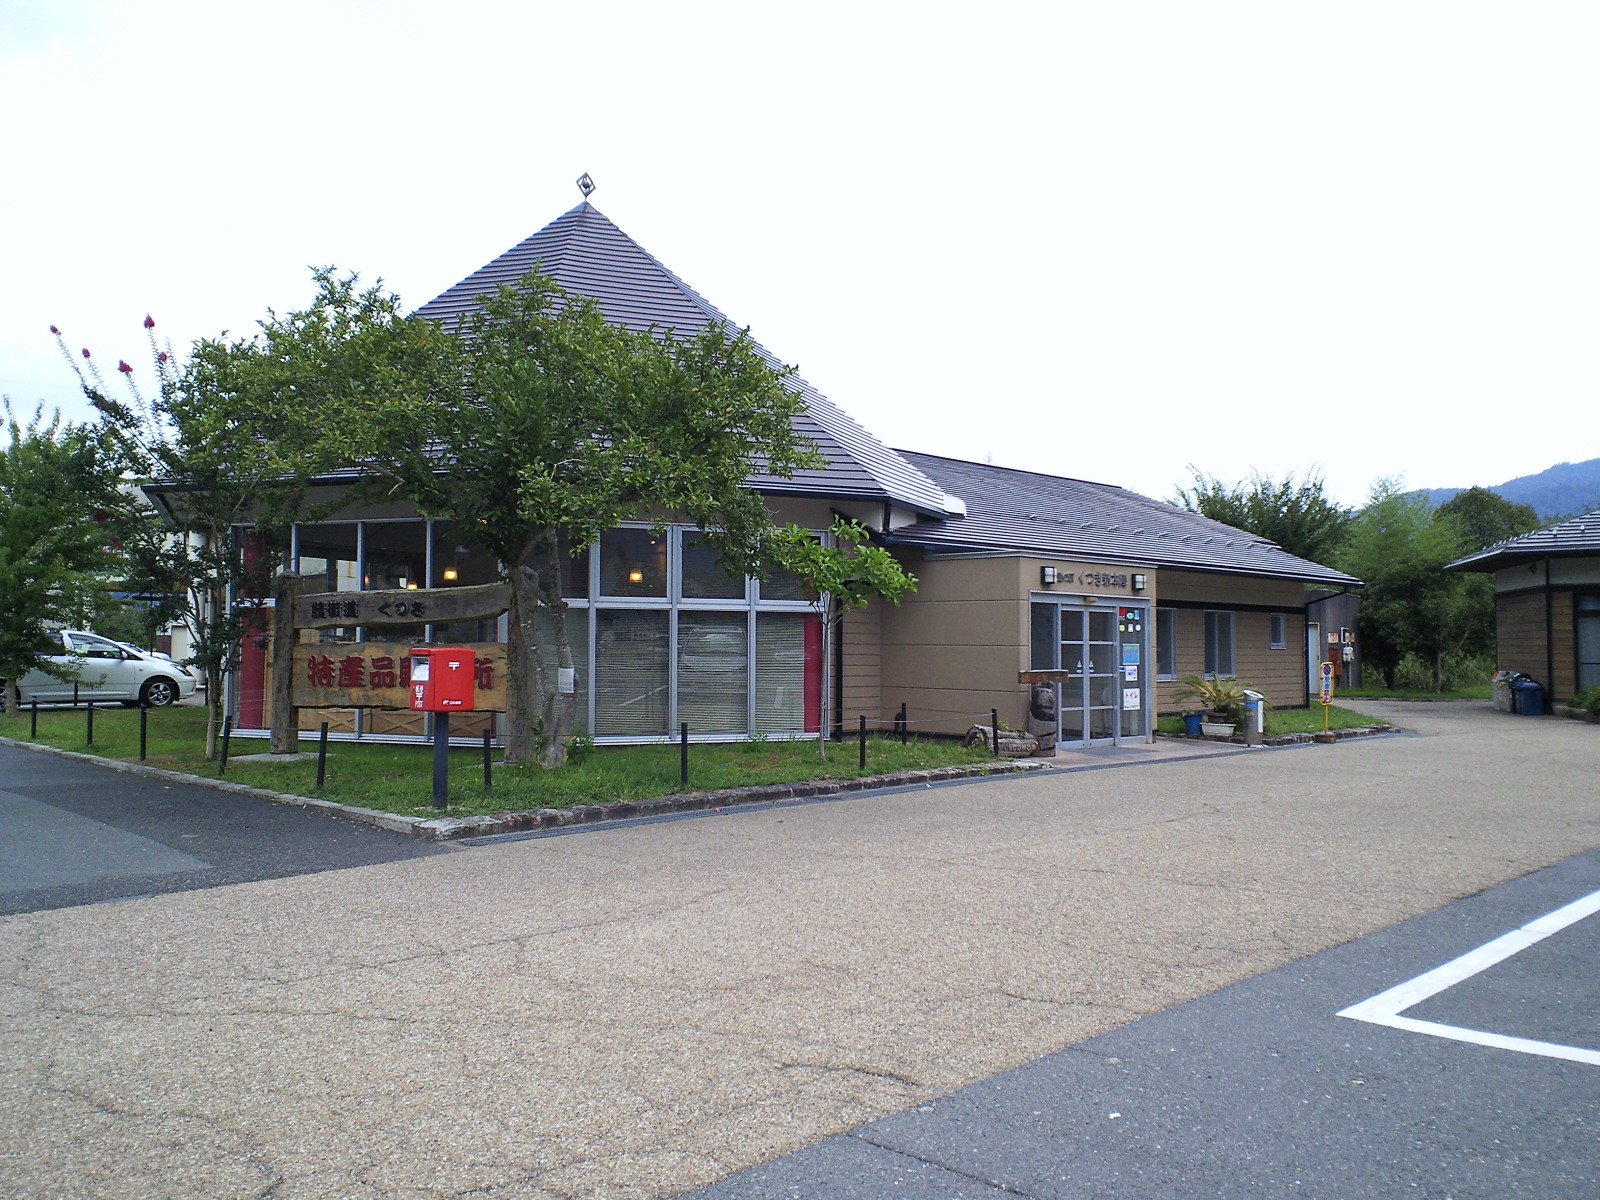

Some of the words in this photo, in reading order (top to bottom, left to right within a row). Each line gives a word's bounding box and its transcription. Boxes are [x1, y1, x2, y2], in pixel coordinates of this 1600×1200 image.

[378, 600, 425, 618] くつき
[307, 655, 493, 690] 特産品所
